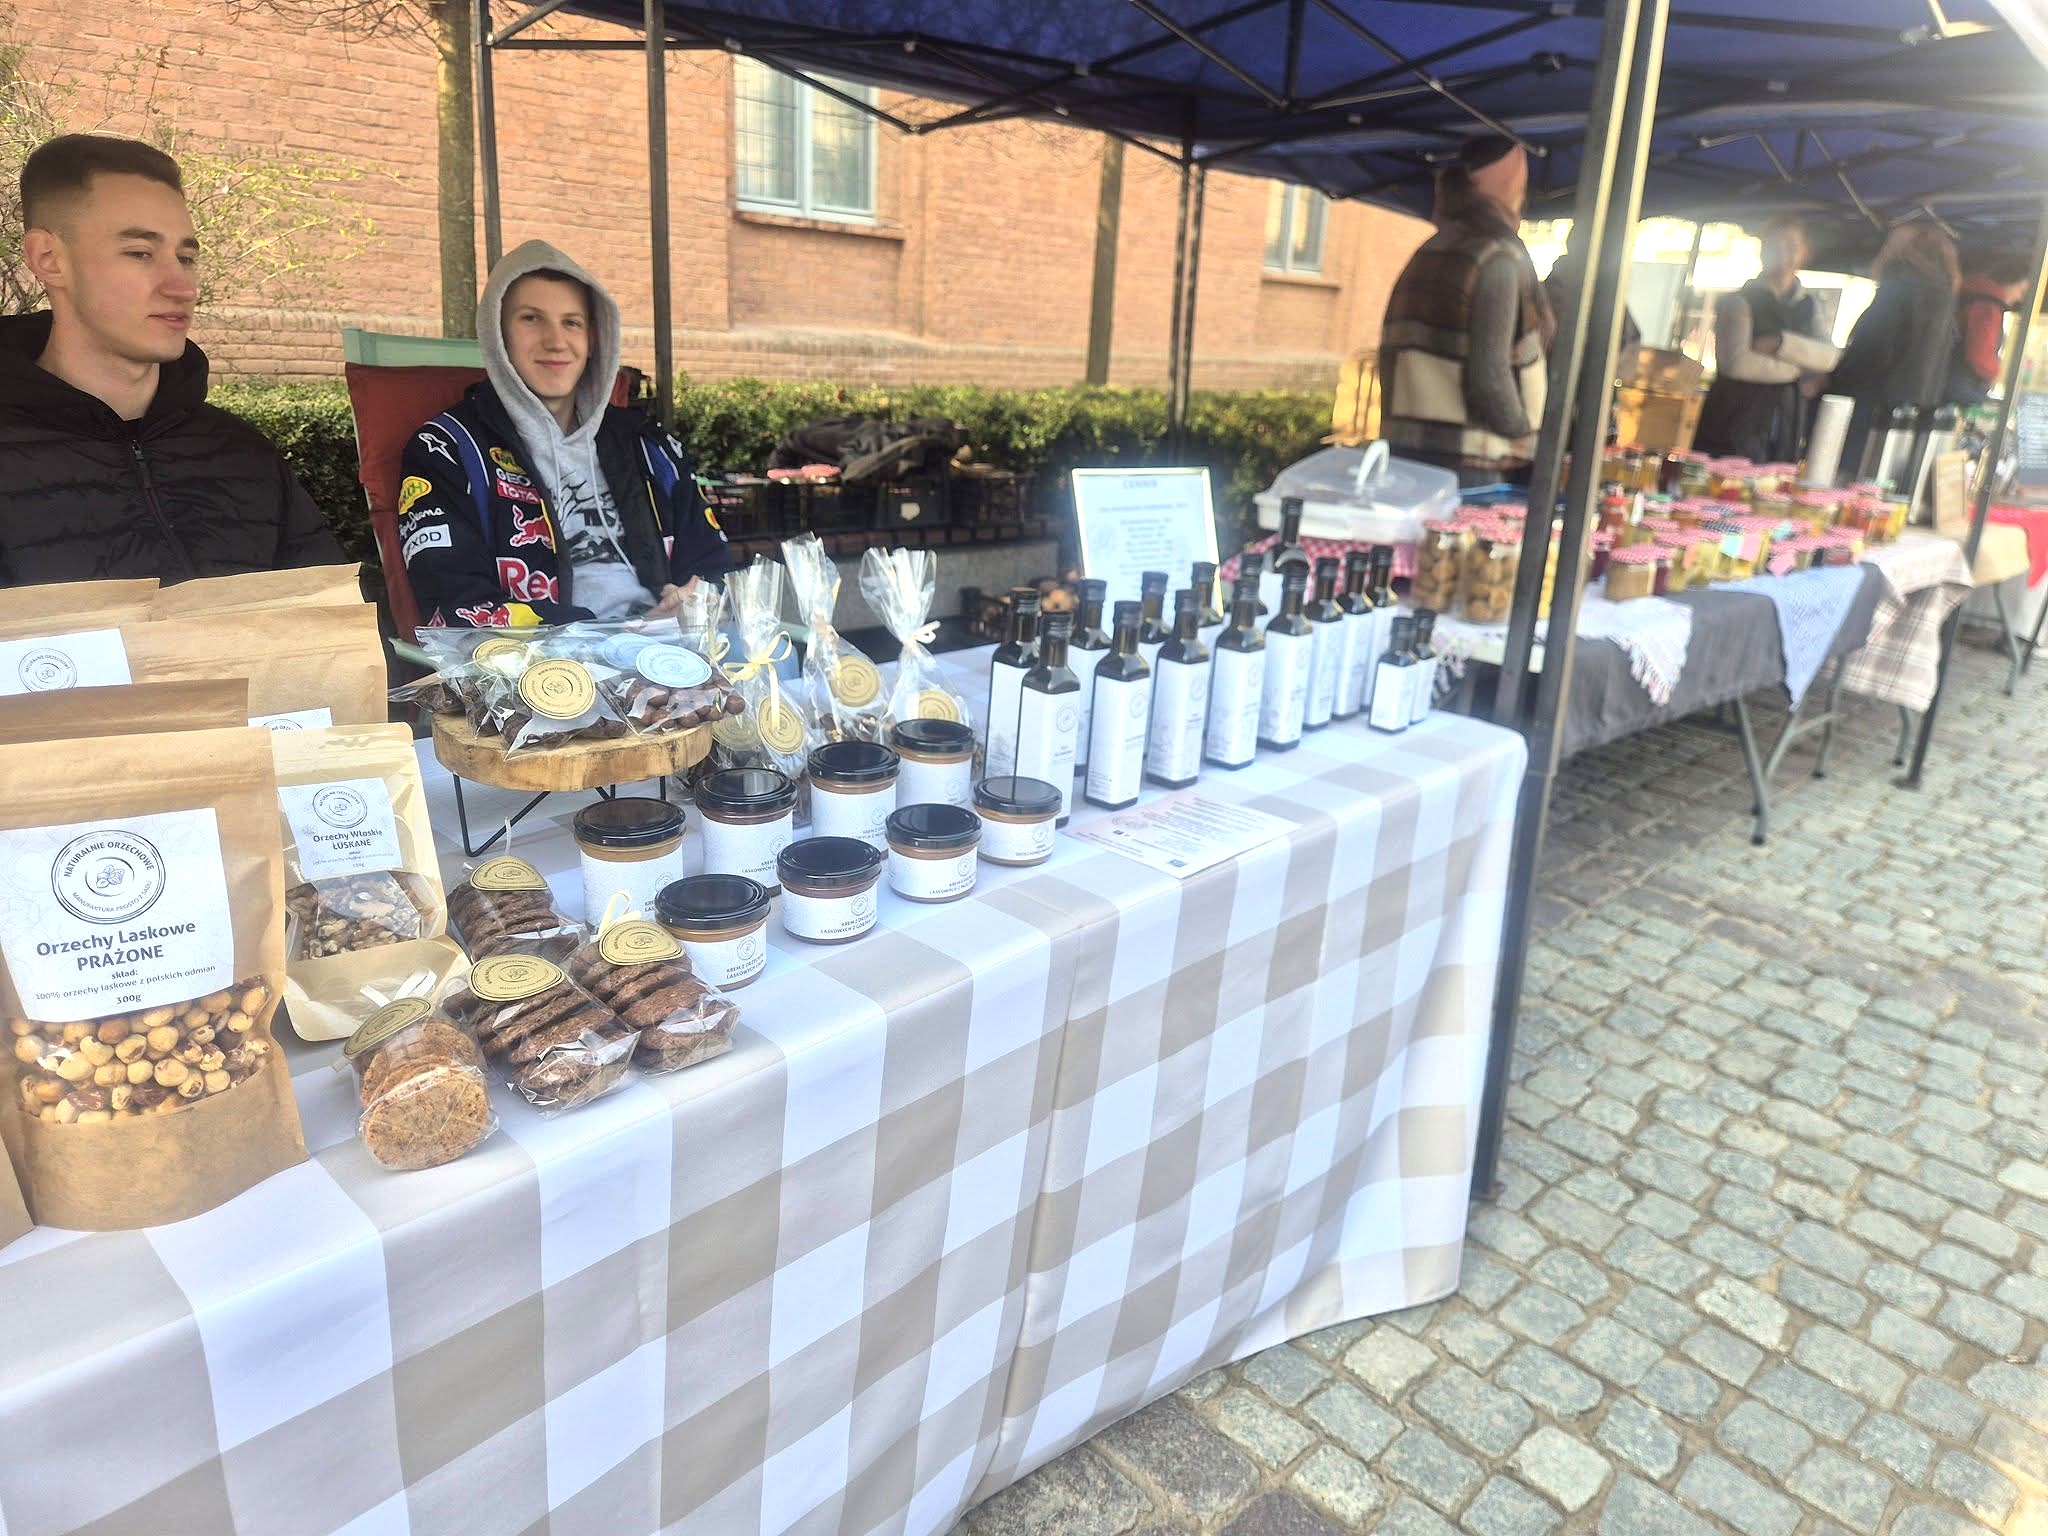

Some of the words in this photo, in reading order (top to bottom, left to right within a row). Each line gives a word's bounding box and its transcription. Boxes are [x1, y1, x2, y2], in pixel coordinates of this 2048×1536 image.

[313, 830, 349, 842] Orzechy
[350, 828, 383, 838] Włoskie
[332, 838, 372, 850] ŁUSKANE
[64, 841, 105, 878] NATURALNIE
[107, 841, 155, 871] ORZECHOWE
[71, 891, 115, 913] MANUFAKTURA
[115, 897, 140, 912] PROSTO
[143, 880, 153, 897] SADU
[36, 934, 114, 956] Orzechy
[118, 922, 196, 944] Laskowe
[76, 944, 165, 971] PRAŻONE
[36, 991, 61, 1000] 100%
[63, 985, 99, 998] orzechy
[100, 979, 137, 992] laskowe
[146, 970, 183, 984] polskich
[184, 964, 216, 977] odmian
[111, 968, 138, 980] skład:
[116, 993, 142, 1005] 300g
